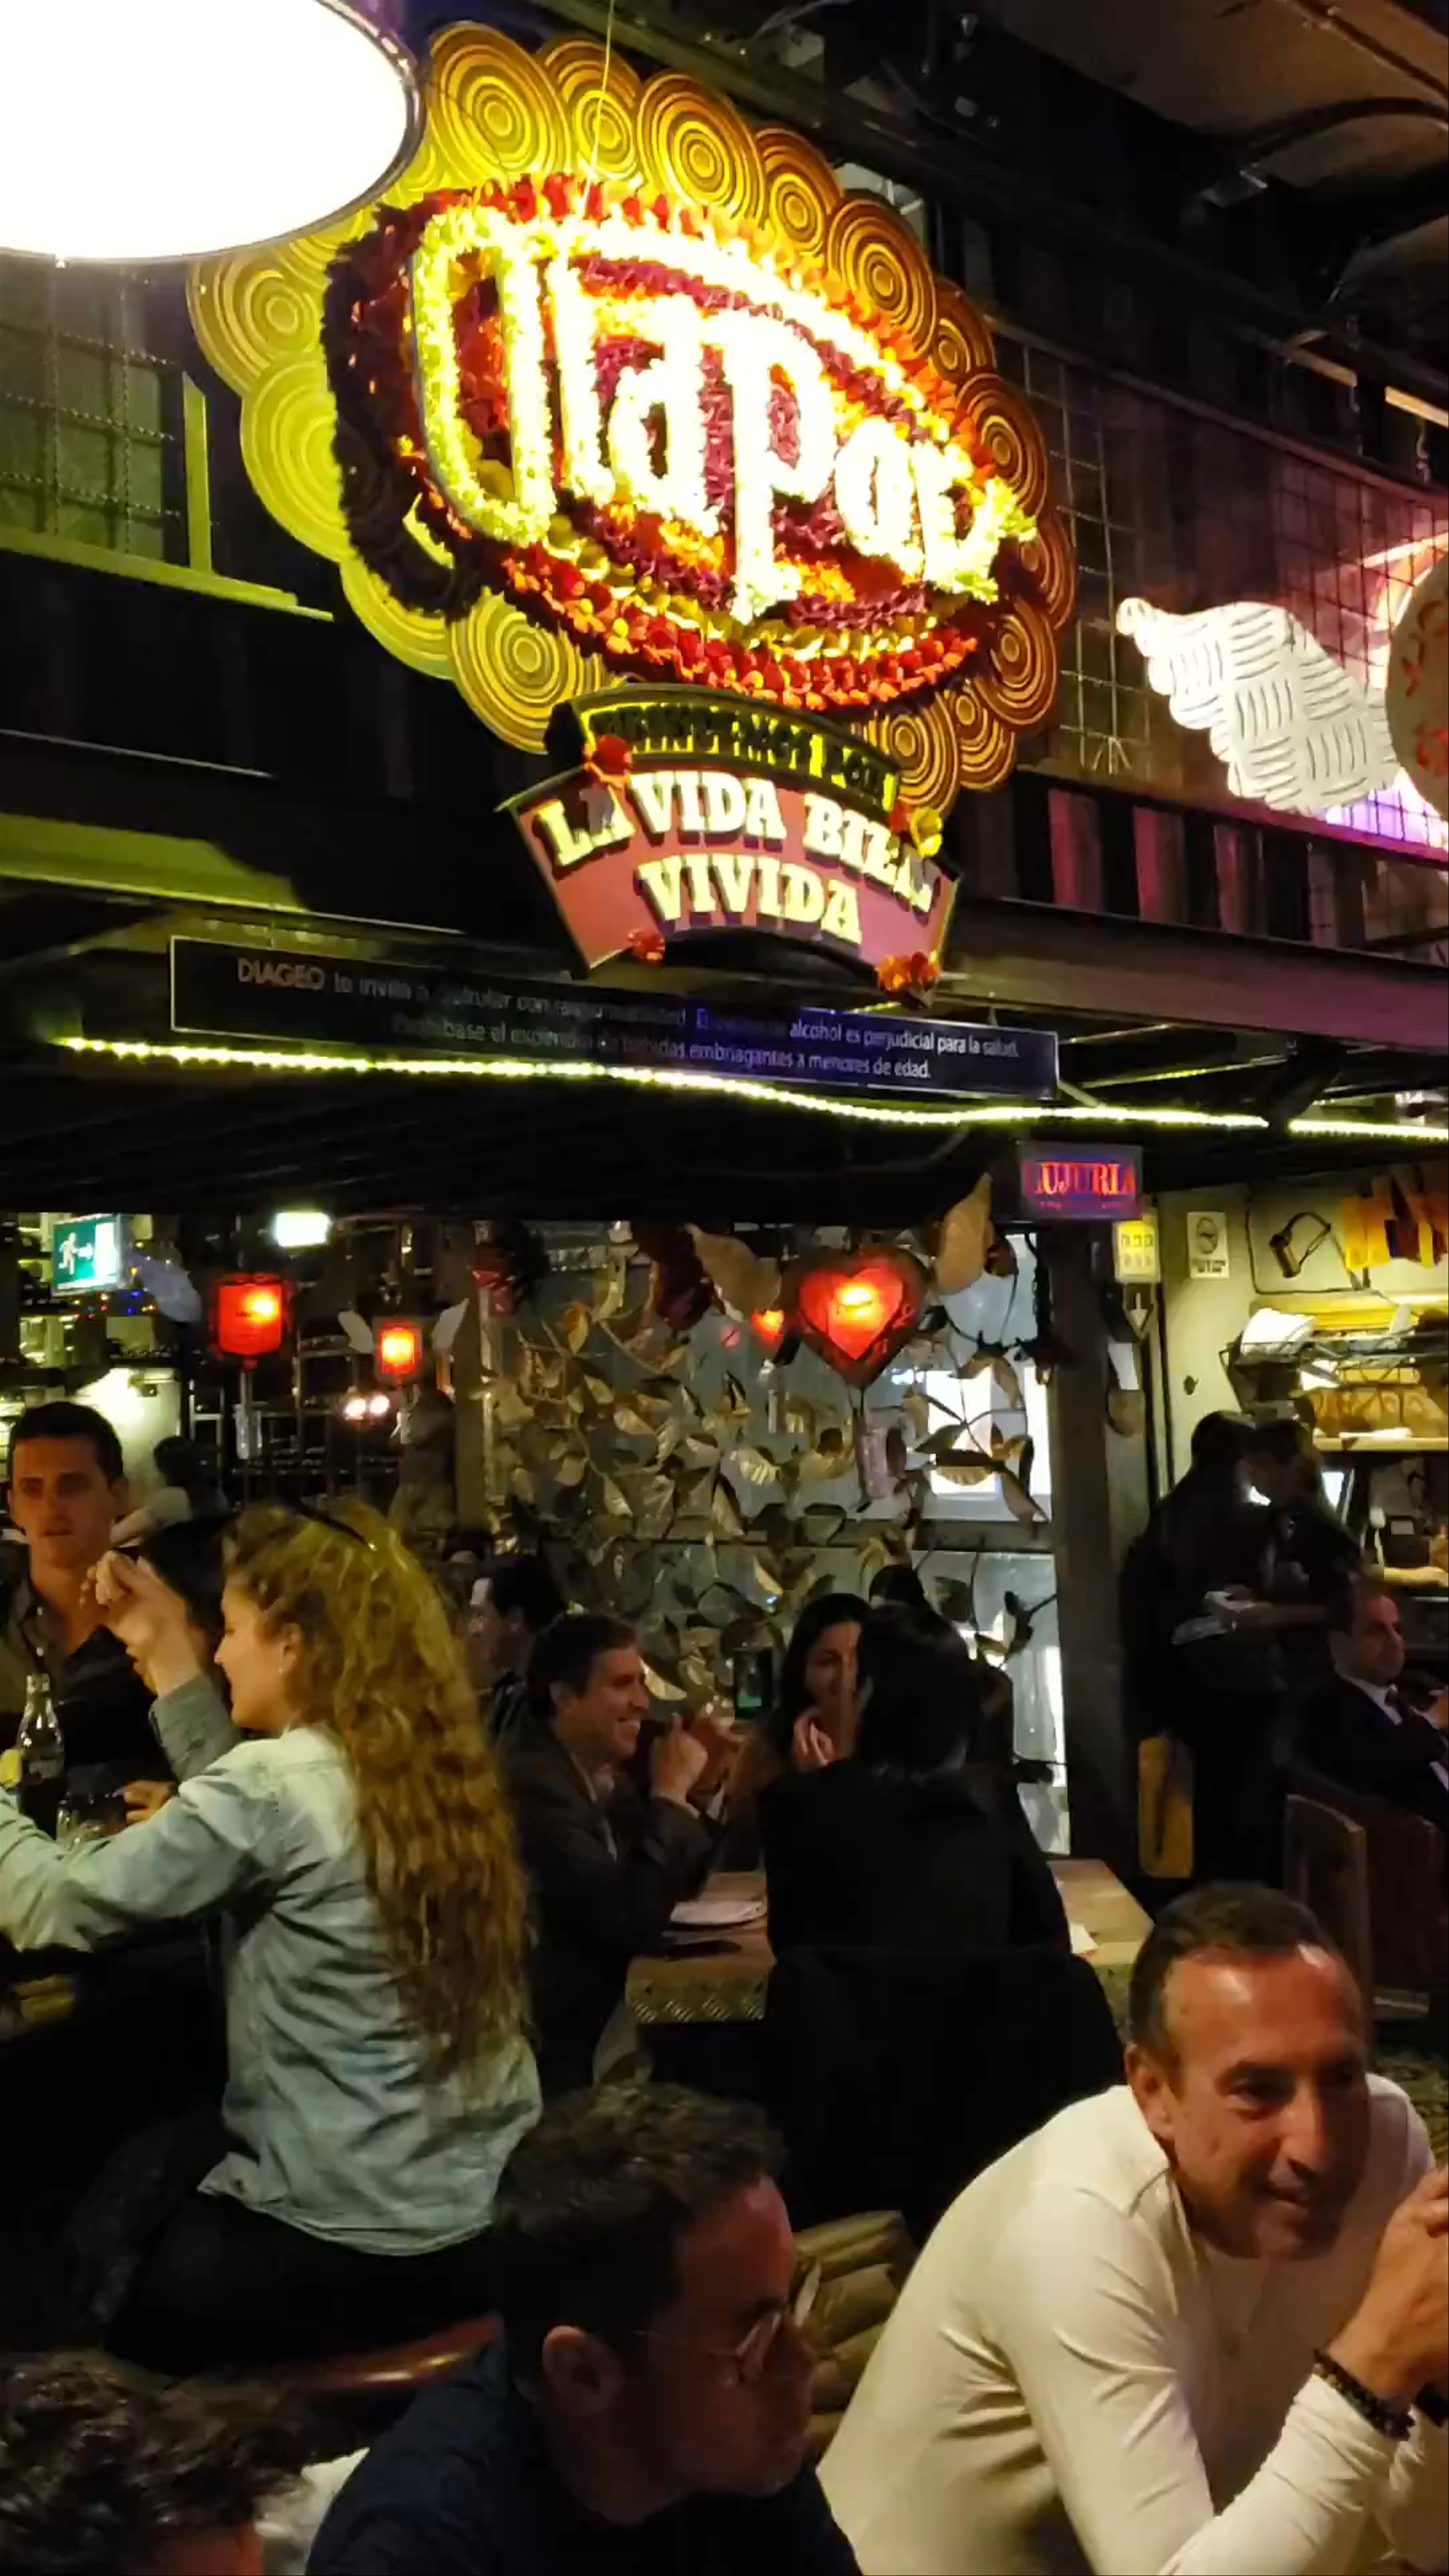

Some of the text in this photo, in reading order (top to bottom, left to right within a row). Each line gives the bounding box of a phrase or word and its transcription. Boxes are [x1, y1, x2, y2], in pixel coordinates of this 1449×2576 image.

[537, 777, 636, 866] LA
[625, 770, 787, 839] VIDA
[638, 854, 863, 945] VIVIDA
[238, 957, 325, 989] DIAGEO
[789, 1018, 842, 1041] alcohol
[845, 1028, 860, 1043] es
[863, 1029, 934, 1052] perjudicial
[938, 1035, 966, 1056] para
[968, 1035, 980, 1053] la
[689, 1040, 793, 1069] embriagantes
[809, 1055, 869, 1075] menores
[873, 1056, 891, 1076] de
[894, 1058, 933, 1079] edad.
